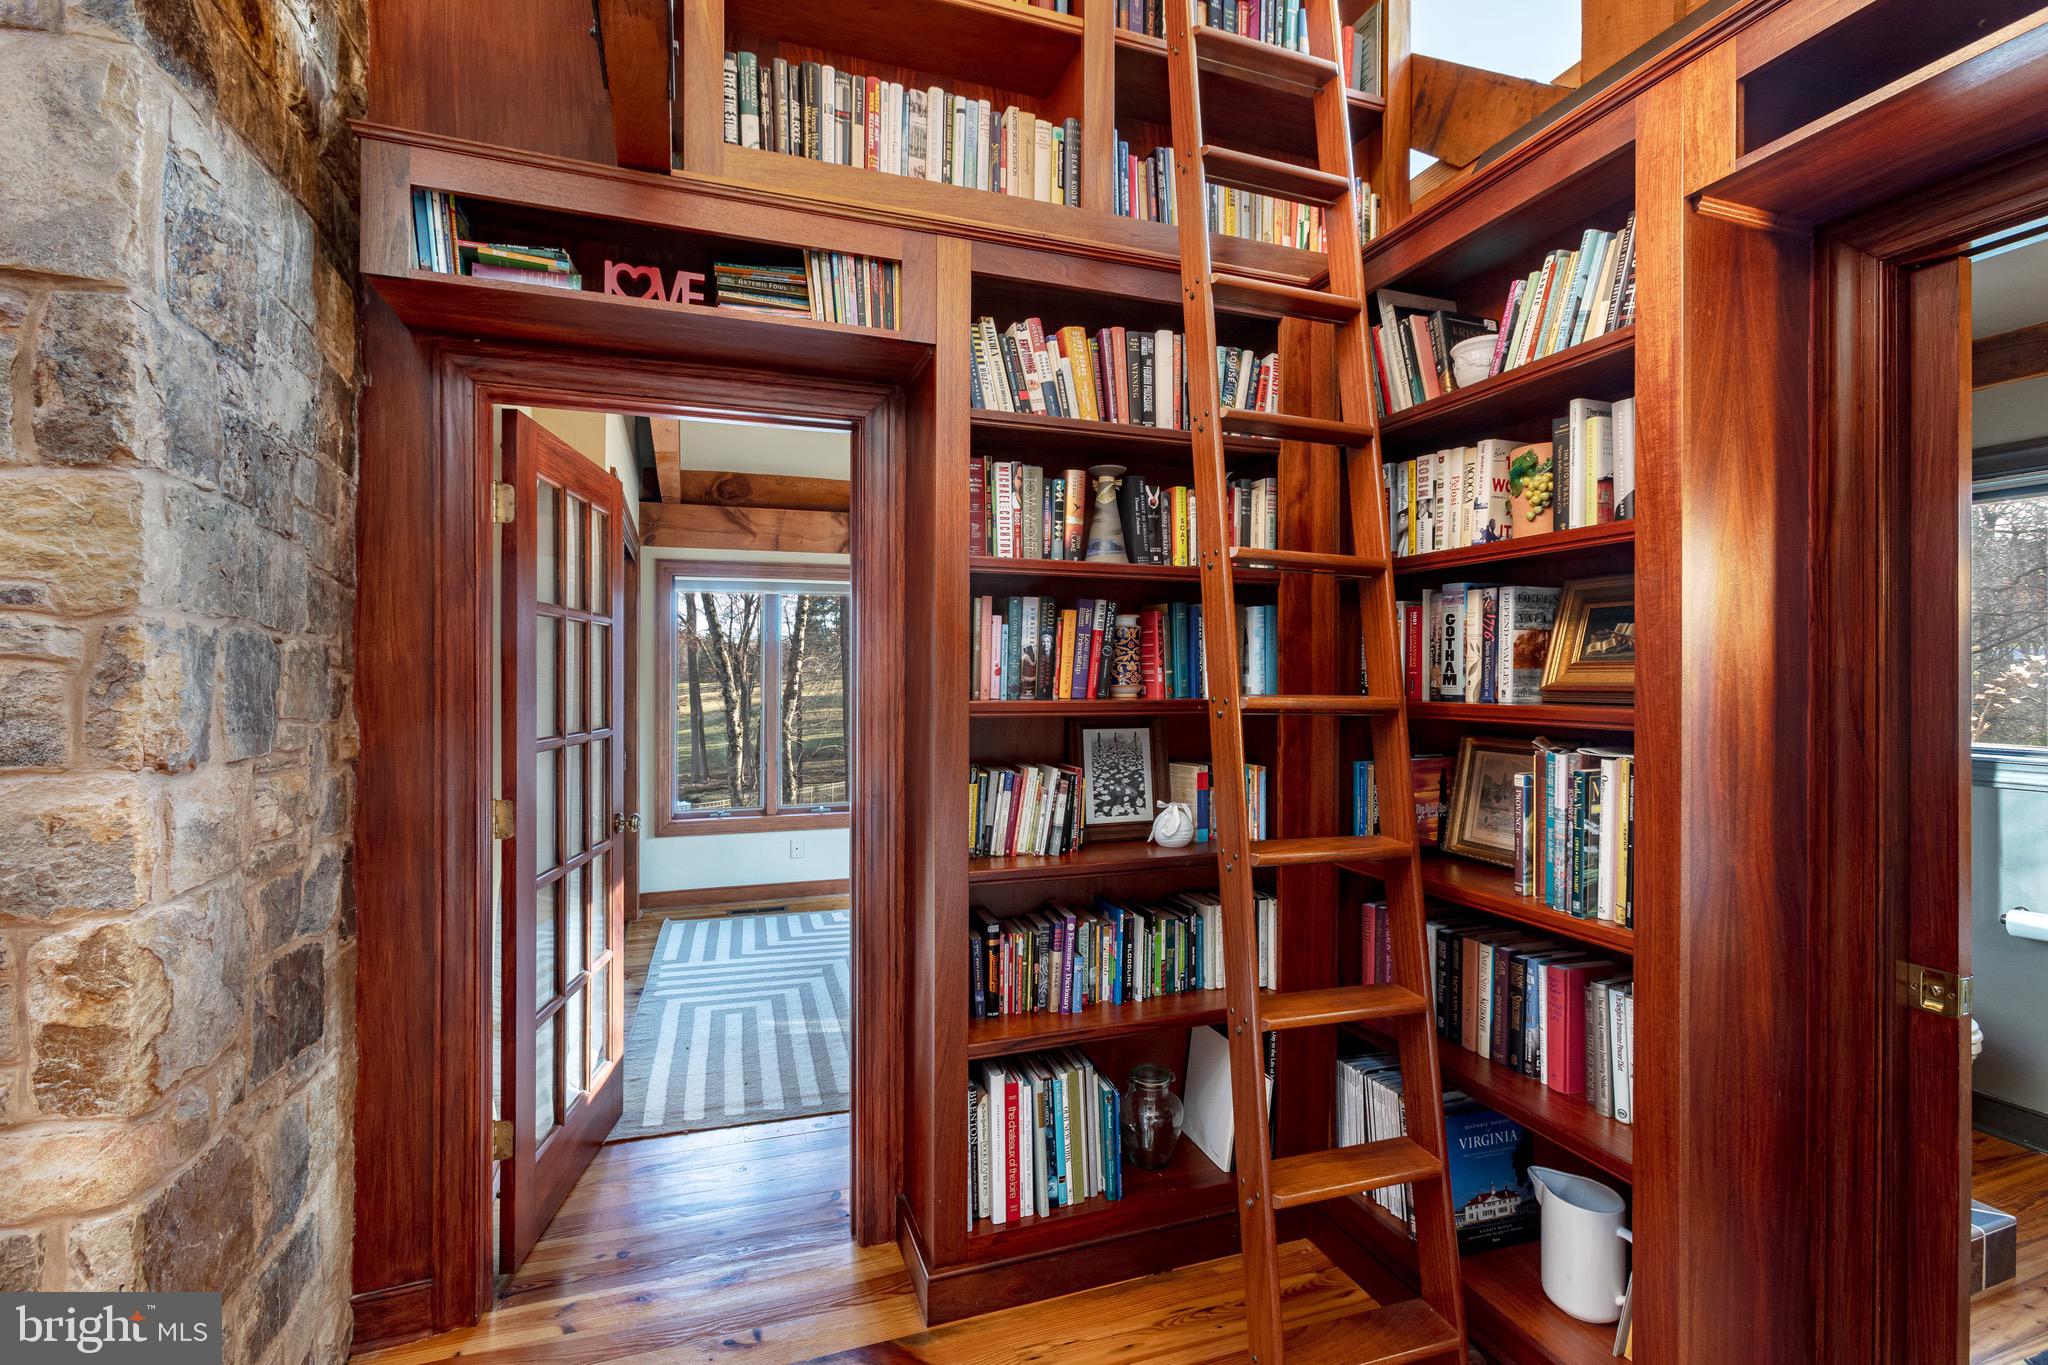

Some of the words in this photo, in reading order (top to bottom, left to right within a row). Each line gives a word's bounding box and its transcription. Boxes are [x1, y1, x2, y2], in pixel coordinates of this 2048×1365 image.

[725, 72, 738, 88] EYE
[792, 100, 800, 117] APRIL
[811, 107, 819, 131] Women
[967, 104, 976, 124] dear
[725, 114, 738, 144] STORM
[792, 119, 800, 144] FOOLS
[811, 132, 819, 148] Who
[967, 126, 977, 149] sister
[1071, 153, 1079, 175] DEAN
[738, 279, 768, 288] ARTEMIS
[768, 282, 788, 291] FOWL
[1533, 259, 1552, 307] ATLANTIC
[1031, 324, 1040, 347] JUSTICE
[1018, 339, 1037, 375] EXPLODING
[1227, 351, 1238, 383] LOUISE
[979, 368, 989, 386] BUZZ
[1131, 363, 1139, 398] WINNING
[1143, 366, 1152, 385] FOURTH
[1143, 385, 1152, 412] PROCEDURE
[998, 466, 1009, 504] MICHAEL
[1418, 458, 1430, 497] ROBIN
[1466, 462, 1475, 504] IACOCCA
[1023, 477, 1038, 508] TOM
[1450, 475, 1461, 506] Pelosi
[999, 510, 1011, 554] CRICHTON
[1023, 510, 1038, 553] WOLFE
[1436, 496, 1444, 546] SEDARIS
[1499, 524, 1512, 538] IT
[1047, 602, 1055, 632] CODE
[1482, 614, 1497, 642] 1776
[1075, 633, 1085, 675] Friendship
[1443, 613, 1457, 686] GOTHAM
[1573, 776, 1583, 802] Martha's
[1514, 790, 1522, 834] PROVENCE
[1573, 804, 1583, 830] Vineyard
[1064, 932, 1075, 971] Elementary
[1062, 973, 1073, 1010] Dictionary
[1480, 977, 1489, 994] STEEL
[1598, 1006, 1606, 1025] Coming
[1615, 1001, 1624, 1022] Berger's
[1598, 1027, 1606, 1051] Computer
[1616, 1022, 1624, 1043] Immune
[1599, 1051, 1607, 1074] Industry
[1617, 1060, 1625, 1071] Diet
[1600, 1074, 1608, 1098] Shakeout
[969, 1090, 978, 1145] BRENTON
[1008, 1106, 1018, 1118] the
[1008, 1121, 1018, 1158] chateaux
[1459, 1129, 1518, 1150] VIRGINIA
[1008, 1158, 1018, 1167] of
[1008, 1168, 1018, 1180] the
[1008, 1180, 1018, 1198] loire
